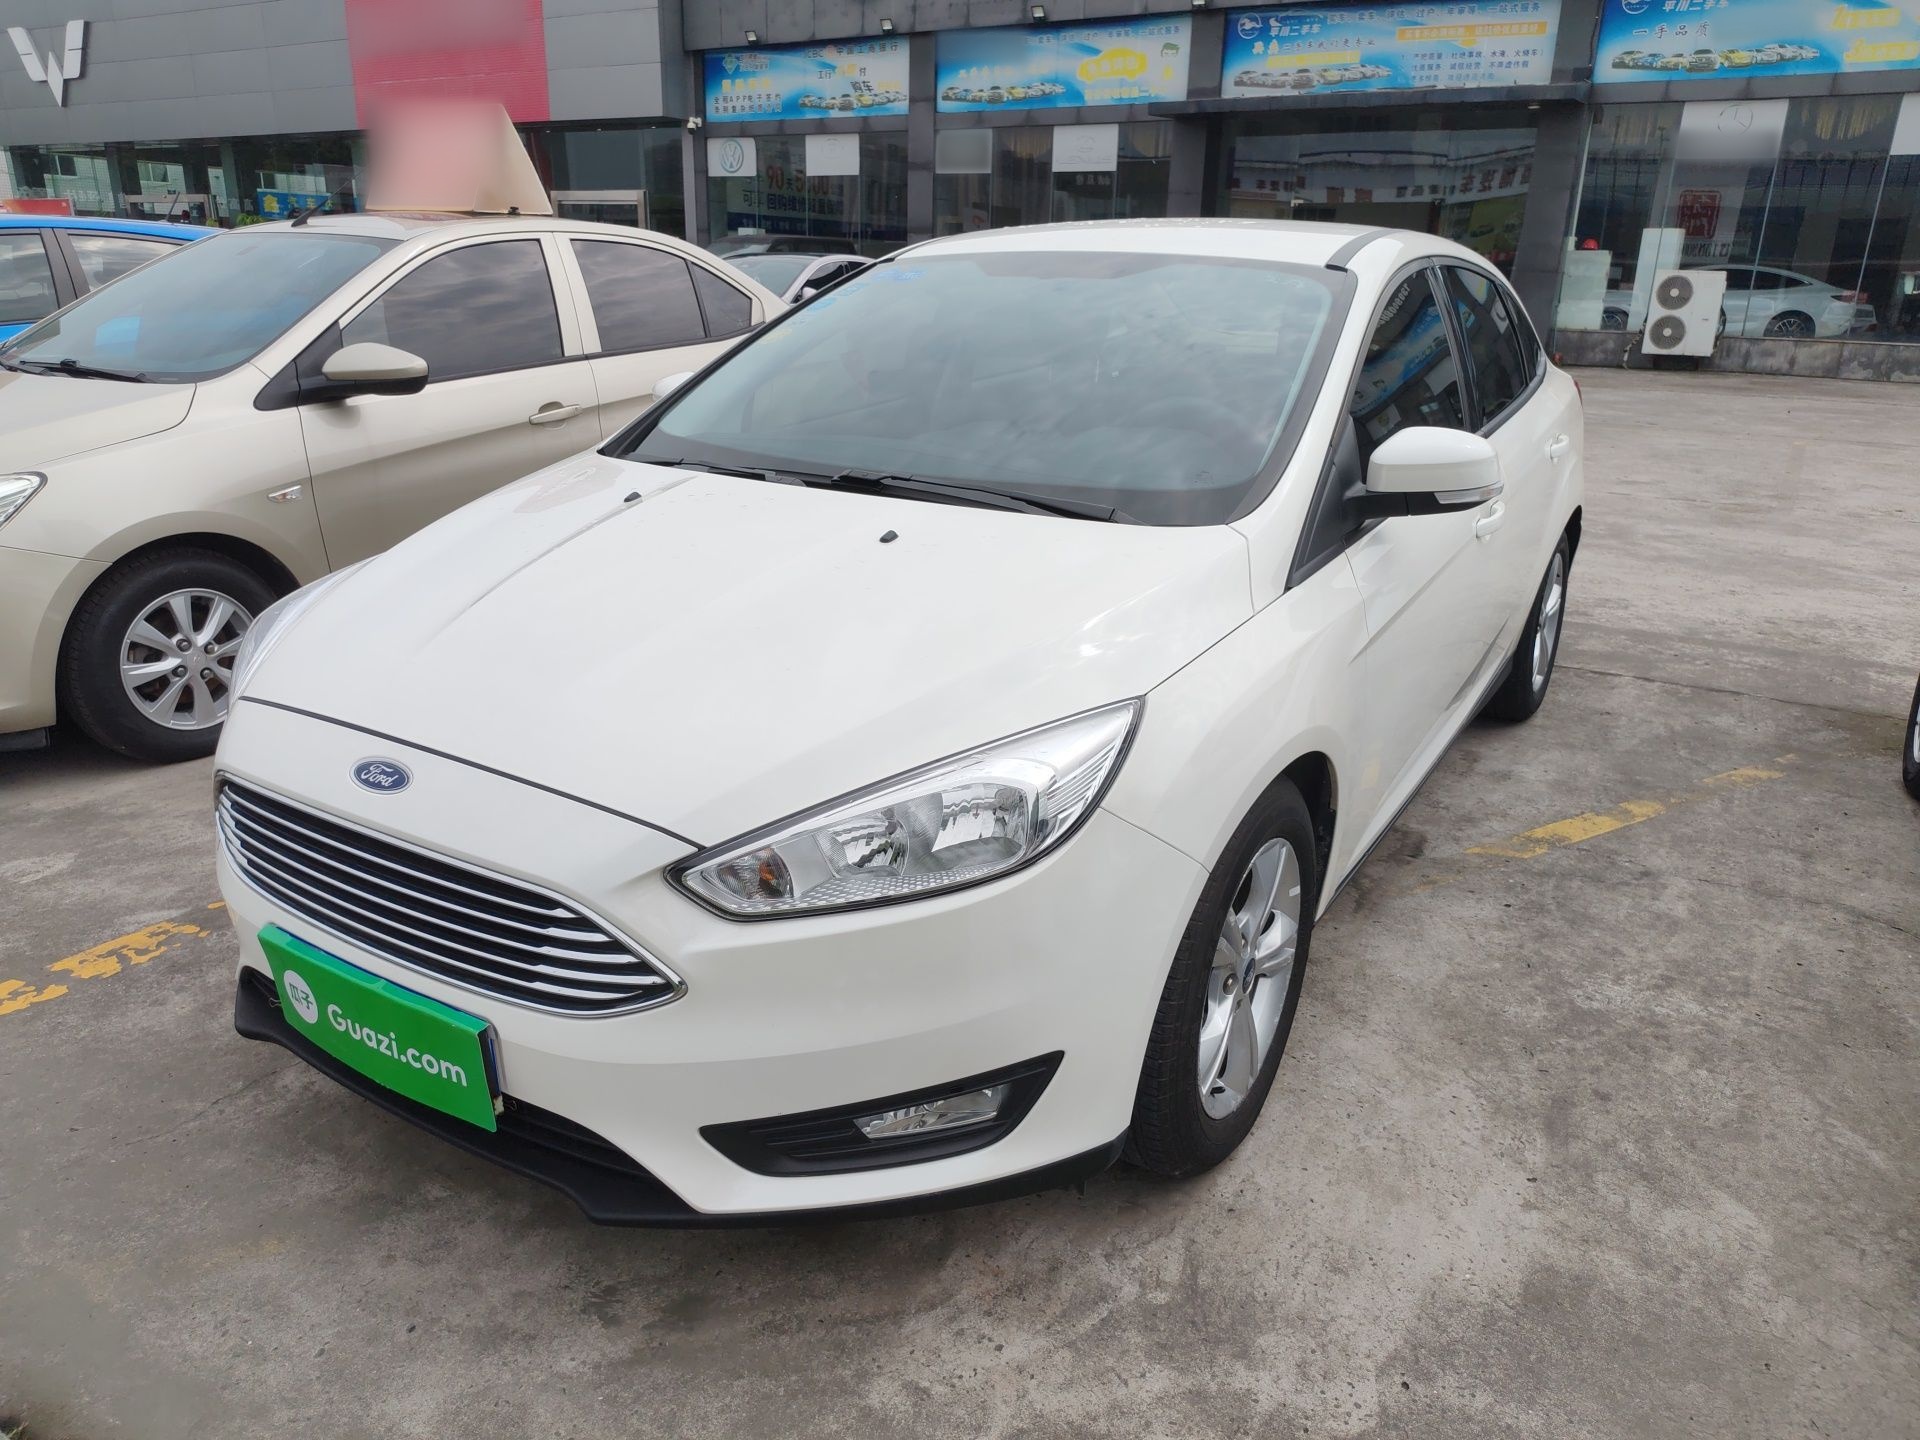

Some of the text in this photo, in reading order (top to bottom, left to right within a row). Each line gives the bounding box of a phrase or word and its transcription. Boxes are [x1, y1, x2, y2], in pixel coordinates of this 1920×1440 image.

[1633, 21, 1710, 39] 一手品质
[361, 763, 399, 787] Ford
[289, 982, 313, 1010] 瓜子
[328, 1005, 467, 1087] Guazi.com
